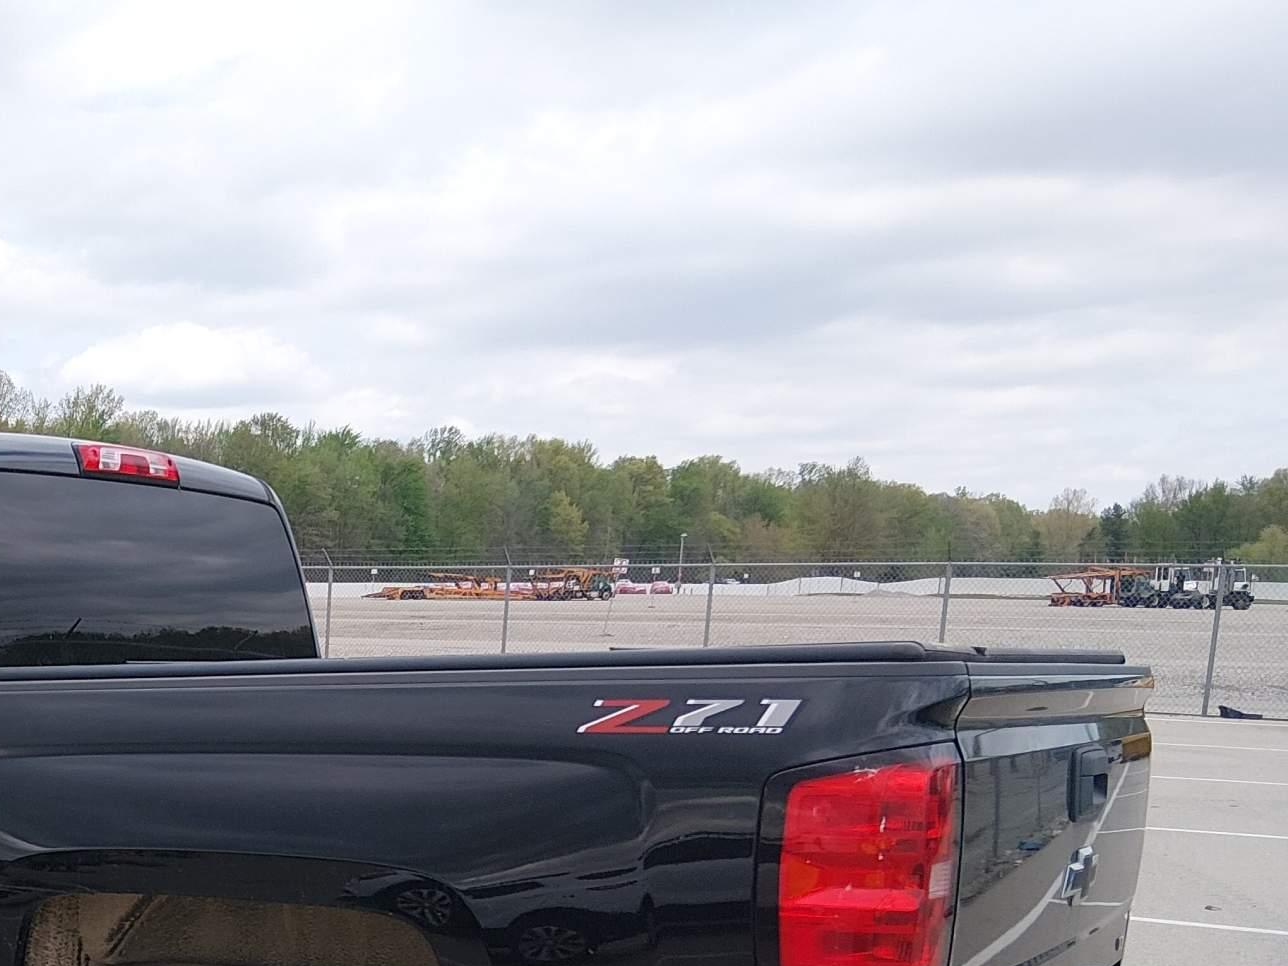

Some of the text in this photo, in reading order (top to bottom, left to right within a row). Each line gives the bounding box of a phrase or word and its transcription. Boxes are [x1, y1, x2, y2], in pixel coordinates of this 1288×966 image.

[576, 699, 802, 734] Z71
[668, 726, 784, 734] OFF ROAD
